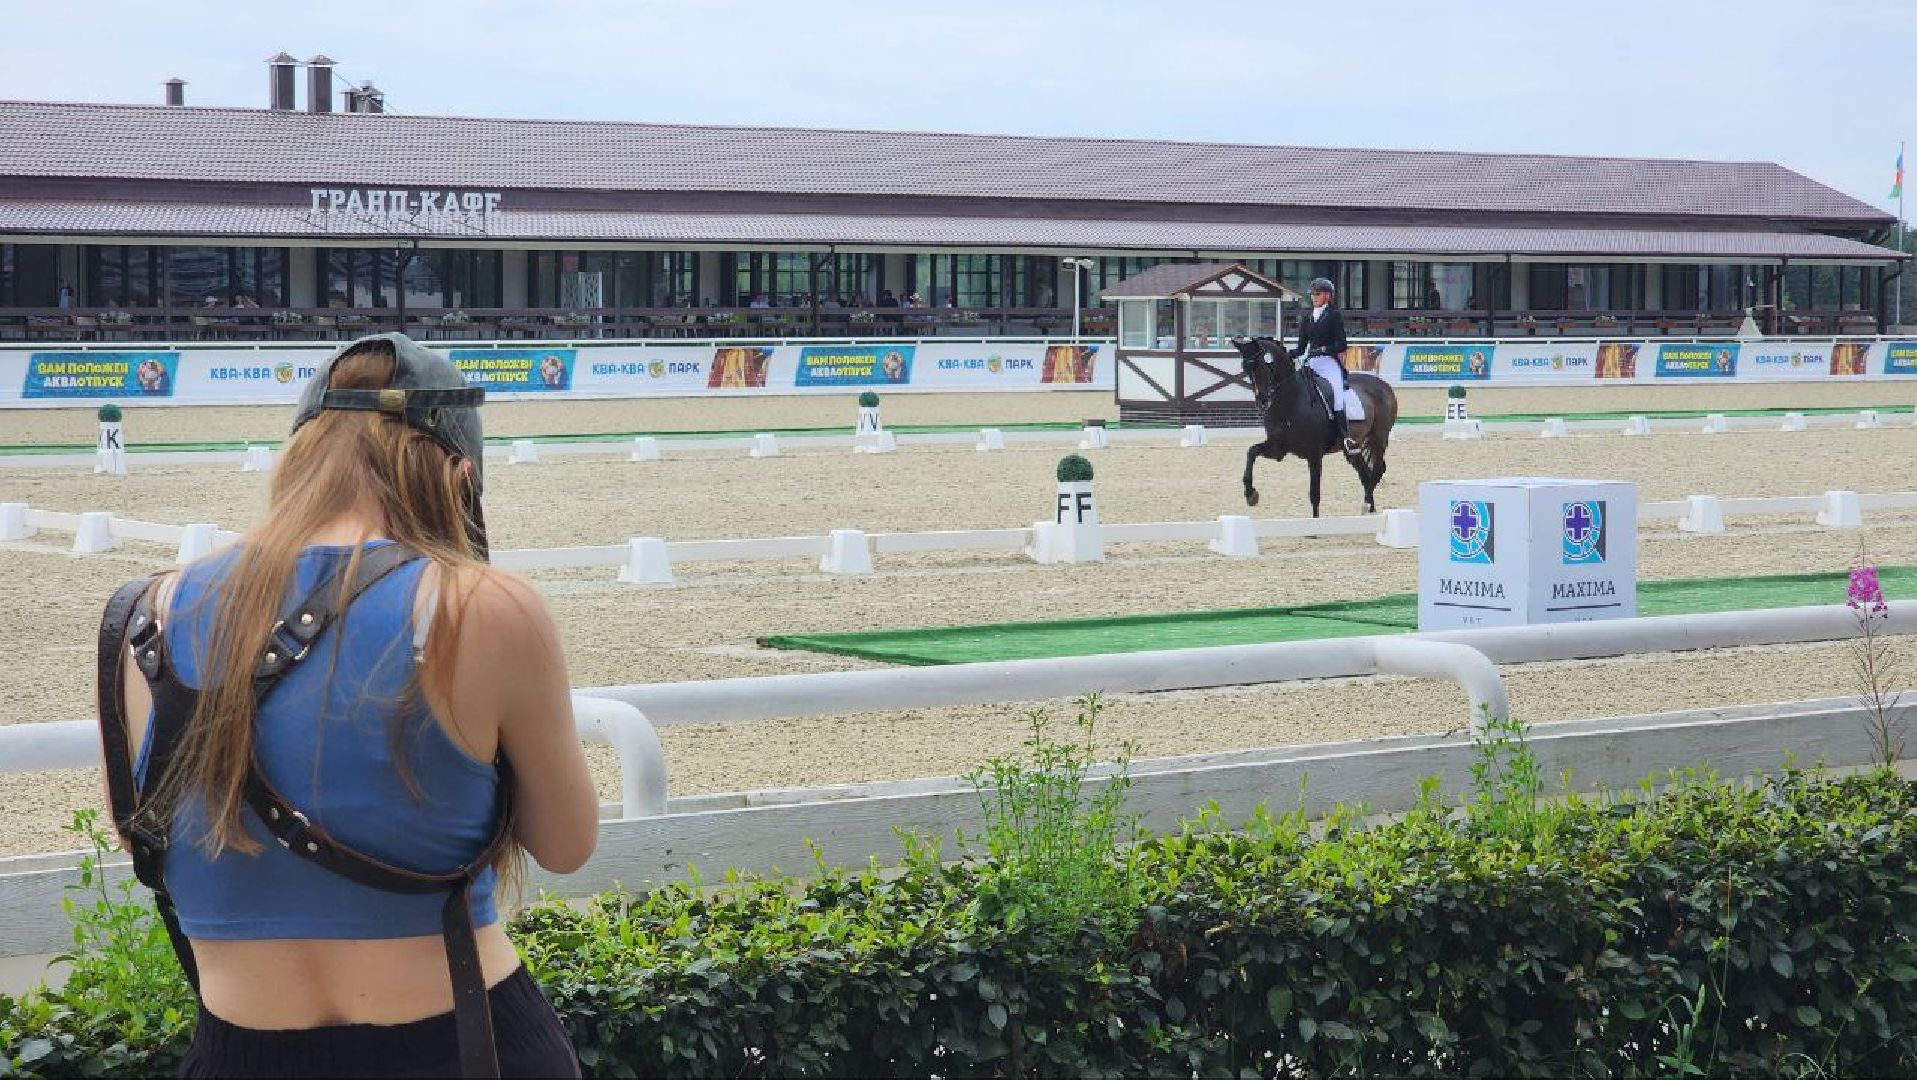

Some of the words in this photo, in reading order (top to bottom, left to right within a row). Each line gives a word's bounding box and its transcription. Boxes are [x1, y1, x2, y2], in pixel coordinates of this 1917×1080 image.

[668, 362, 700, 374] ПАРК
[1005, 359, 1034, 370] ПАРК
[106, 428, 120, 450] K
[1439, 577, 1506, 600] MAXIMA
[1552, 579, 1616, 600] MAXIMA
